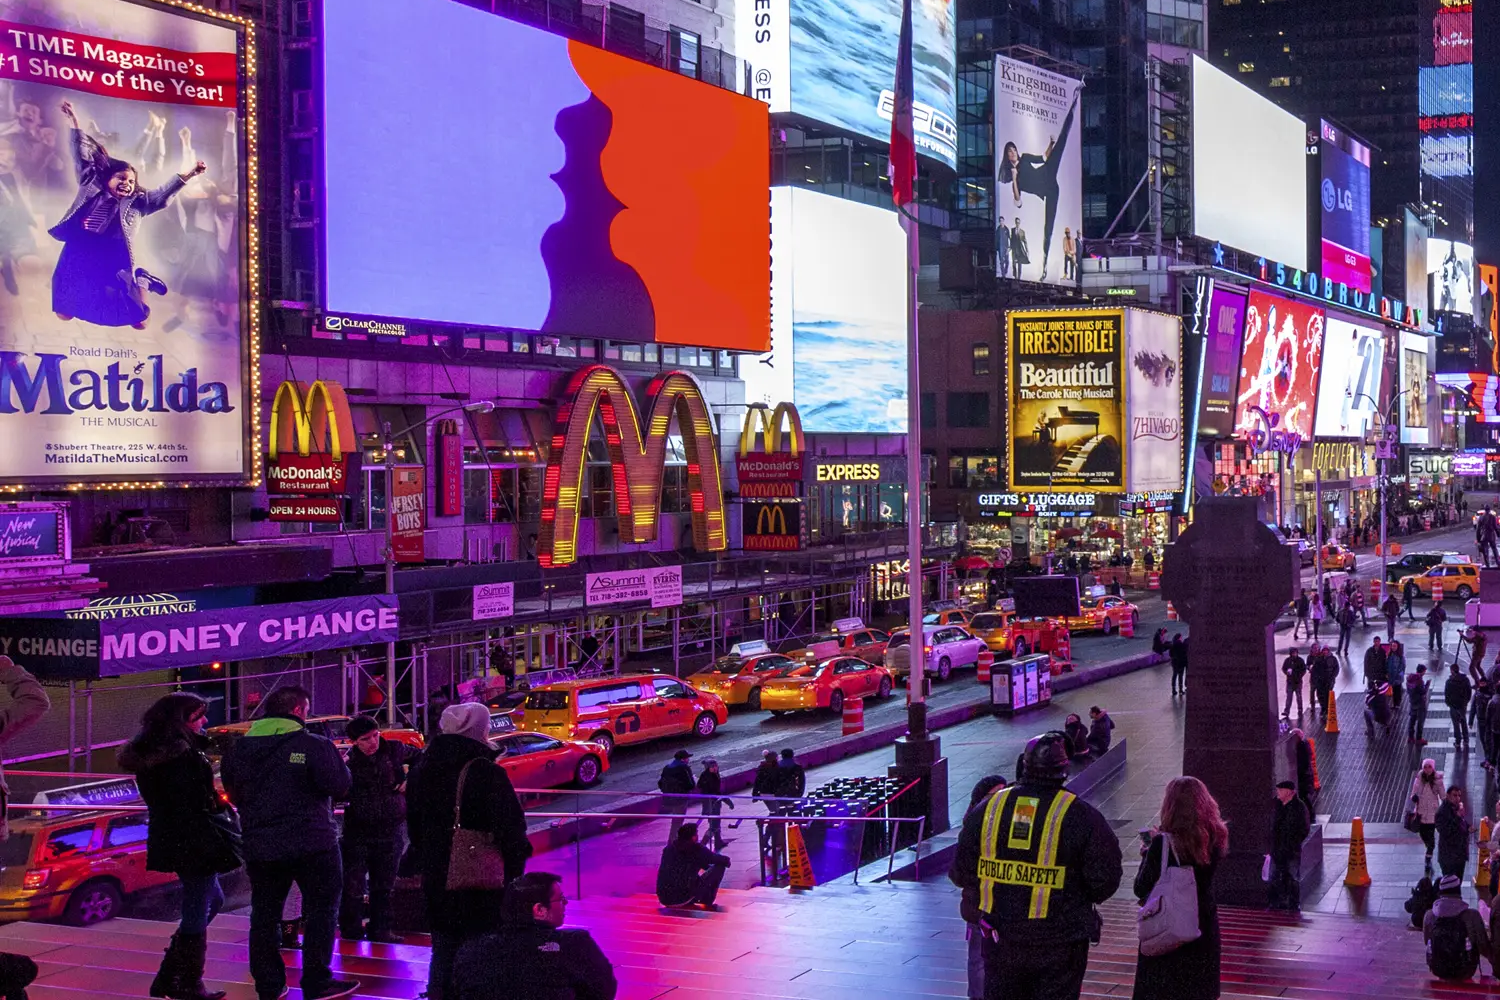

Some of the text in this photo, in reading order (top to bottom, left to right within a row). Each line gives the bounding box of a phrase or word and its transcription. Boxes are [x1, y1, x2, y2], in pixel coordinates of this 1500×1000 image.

[9, 28, 205, 77] TIME Magazine's
[30, 57, 224, 102] Show of the Year!
[1000, 64, 1067, 98] Kingsman
[1000, 82, 1067, 107] THE SECRET SERVICE
[1012, 100, 1058, 120] FEBRUARY 13
[1306, 146, 1318, 155] LG
[1338, 187, 1352, 211] LG
[1324, 278, 1423, 328] BROADWAY
[1048, 320, 1064, 331] JOINS
[1064, 320, 1075, 331] THE
[1076, 320, 1094, 331] RANKS
[1095, 320, 1103, 330] OF
[1103, 320, 1114, 330] THE
[70, 345, 138, 359] Roald Dahl's
[1020, 361, 1114, 388] Beautiful
[0, 352, 236, 415] Matilda
[1020, 387, 1114, 401] The Carole King Musical
[80, 416, 158, 428] THE MUSICAL
[1133, 416, 1178, 437] ZHIVAGO
[53, 442, 88, 451] Shubert
[90, 442, 126, 453] Theatre,
[128, 442, 145, 451] 225
[178, 442, 189, 451] St.
[44, 453, 189, 465] MatildaTheMusical.com
[740, 461, 800, 471] McDonald's
[1312, 442, 1352, 473] FOREVER
[268, 464, 342, 481] McDonald's
[817, 463, 880, 481] EXPRESS
[279, 480, 330, 490] Restaurant
[392, 493, 424, 513] JERSEY
[979, 494, 1095, 505] GIFTS LUGGAGE
[270, 505, 337, 515] OPEN 24 HOURS
[397, 511, 421, 530] BOYS
[600, 574, 646, 587] Summit
[653, 574, 680, 584] EVEREST
[483, 586, 510, 596] Summit
[590, 593, 600, 601] TEL
[121, 602, 197, 617] EXCHANGE
[103, 607, 399, 660] MONEY CHANGE
[18, 638, 98, 658] CHANGE
[979, 858, 1060, 886] PUBLIC SAFETY
